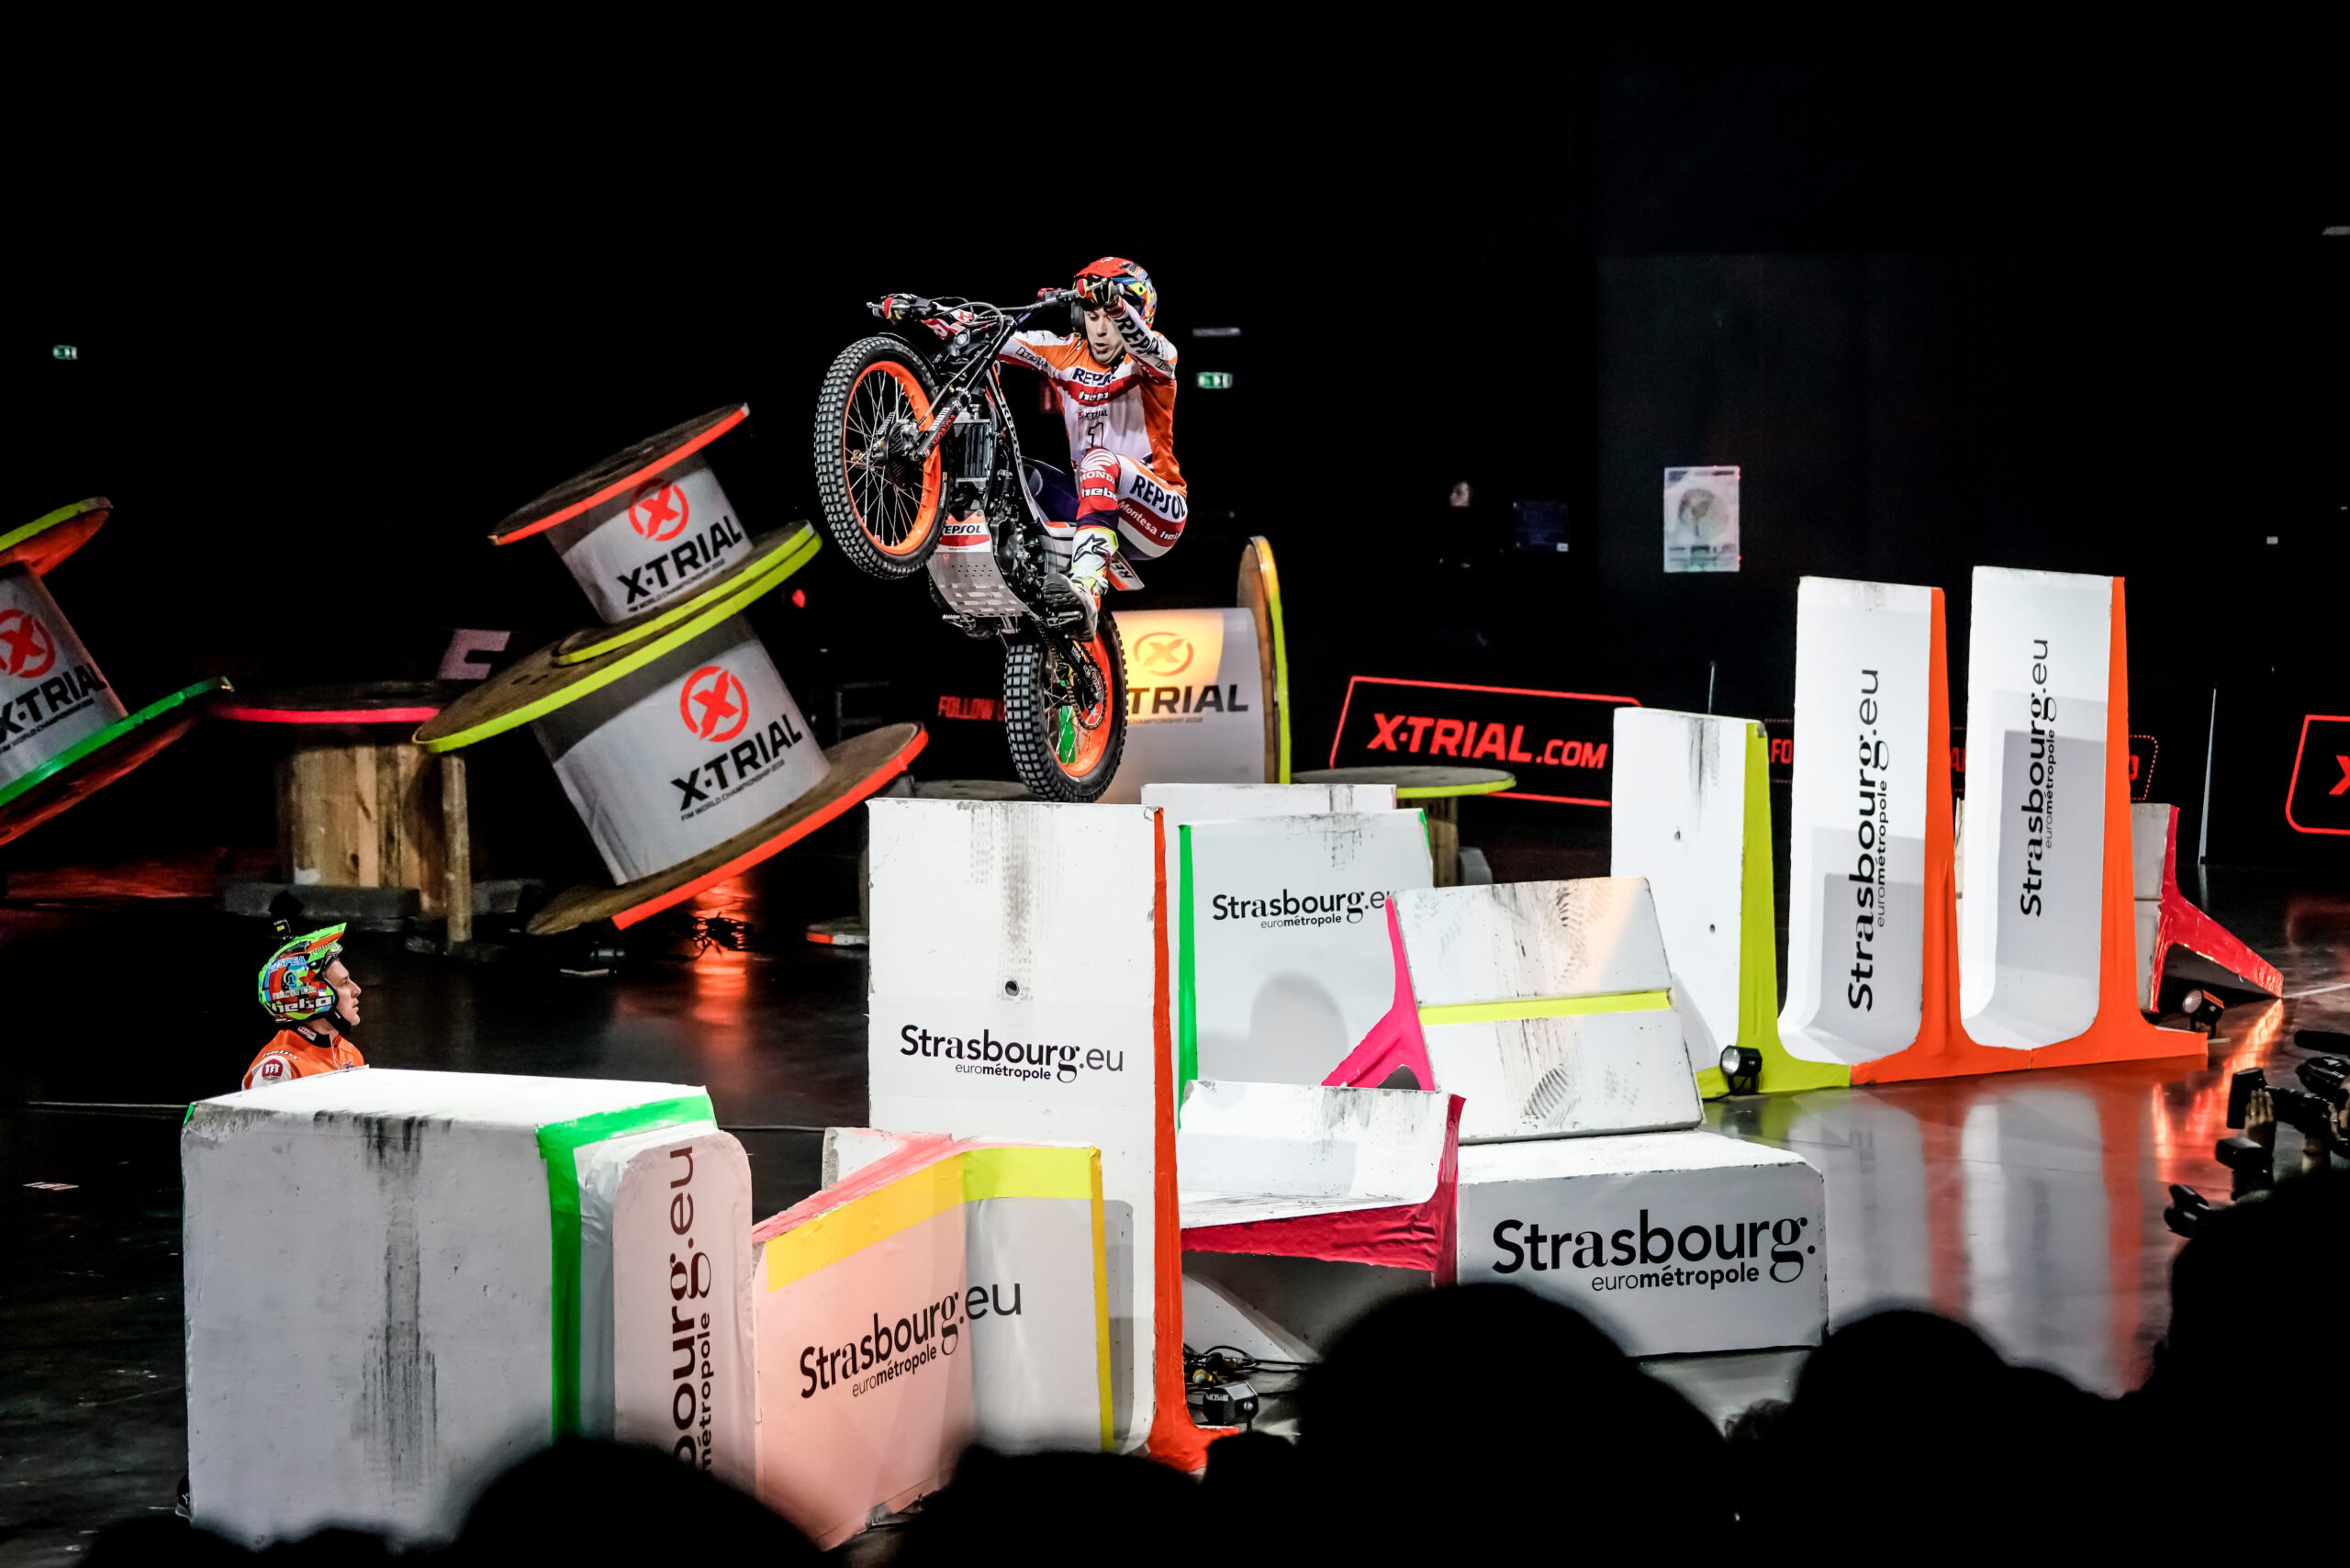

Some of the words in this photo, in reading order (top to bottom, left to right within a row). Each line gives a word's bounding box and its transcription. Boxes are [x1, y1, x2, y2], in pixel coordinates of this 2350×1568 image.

[1118, 500, 1158, 536] Montesa
[1129, 474, 1186, 520] REPSOL
[1127, 684, 1249, 715] TRIAL
[2019, 638, 2057, 918] Strasbourg.eu
[2043, 729, 2057, 849] eurométropole
[1847, 668, 1889, 1013] Strasbourg.eu
[1874, 779, 1889, 928] eurométropole
[1212, 889, 1391, 924] Strasbourg.e
[1260, 913, 1342, 929] eurométropole
[900, 1024, 1124, 1083] Strasbourg.eu
[955, 1062, 1052, 1081] eurométropole
[1492, 1209, 1817, 1283] Strasbourg.
[1591, 1260, 1760, 1292] eurométropole
[800, 1283, 1022, 1399] Strasbourg.eu
[852, 1343, 937, 1397] eurométropole
